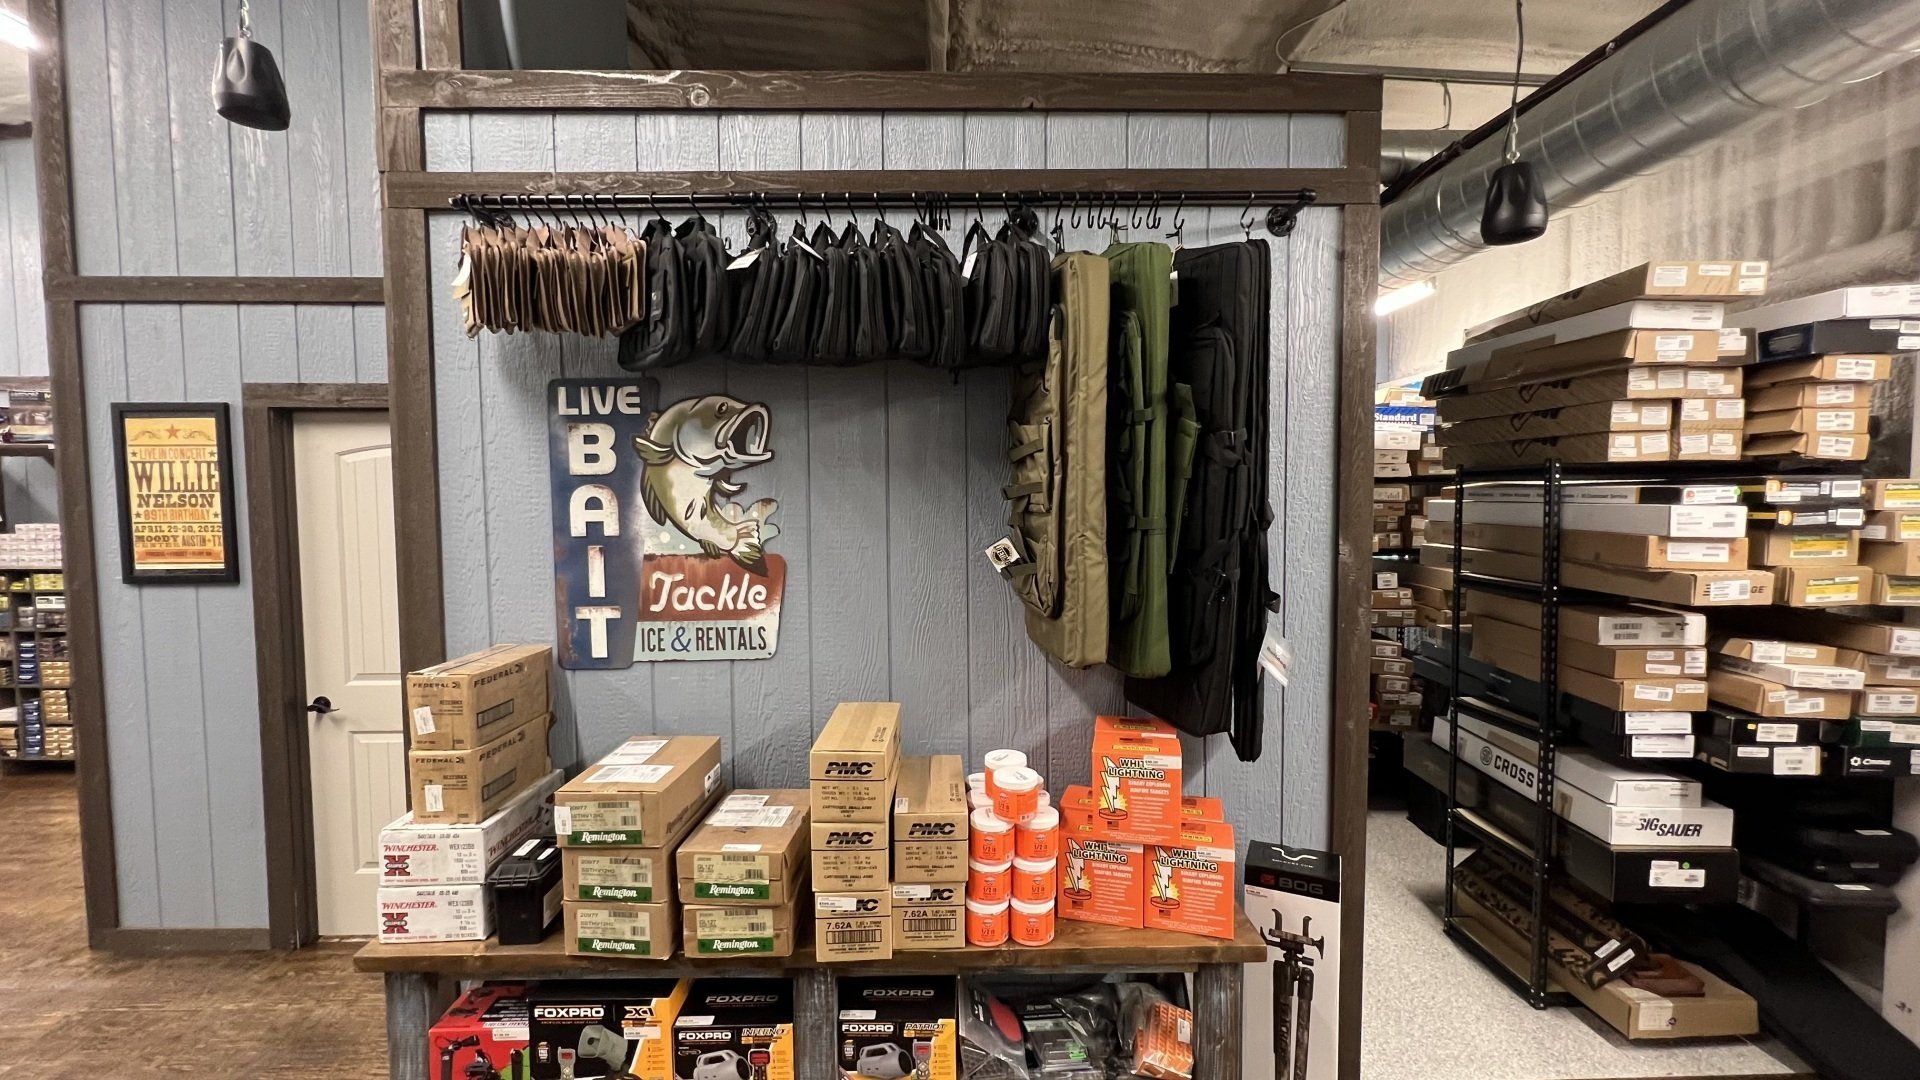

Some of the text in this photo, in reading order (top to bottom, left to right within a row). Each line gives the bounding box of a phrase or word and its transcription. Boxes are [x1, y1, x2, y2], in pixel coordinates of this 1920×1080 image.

[557, 386, 641, 415] LIVE
[1374, 412, 1418, 422] Standard
[140, 448, 206, 459] LIVE IN CONCERT
[130, 460, 220, 492] WILLIE
[137, 493, 214, 508] NELSON
[144, 509, 210, 520] 89TH BIRTHDAY
[135, 525, 164, 533] APRIL
[198, 525, 222, 533] 2022
[182, 535, 223, 547] AUSTIN TX
[567, 423, 621, 658] BAIT
[649, 571, 767, 612] Tackle
[641, 626, 767, 652] ICE & RENTALS
[474, 668, 514, 689] FEDERAL
[479, 735, 517, 762] FEDERAL
[825, 762, 873, 775] PMC
[1120, 758, 1145, 768] WHIT
[1108, 767, 1165, 779] LIGHTNING
[1494, 755, 1534, 788] CROSS
[909, 822, 956, 835] PMC
[1636, 818, 1703, 837] SIG SAUER
[581, 831, 627, 844] Remington
[826, 831, 873, 845] PMC
[383, 844, 438, 852] WINCHESTER
[1084, 842, 1108, 851] WHIT
[1073, 849, 1127, 862] LIGHTNING
[1172, 848, 1197, 859] WHIT
[1160, 857, 1217, 871] LIGHTNING
[709, 884, 754, 897] Remington
[1279, 877, 1323, 895] BOG
[593, 886, 637, 899] Remington
[381, 901, 437, 909] WINCHESTER
[826, 922, 852, 930] 7.62A
[592, 939, 636, 951] Remington
[713, 939, 759, 951] Remington
[705, 995, 779, 1003] FOXPRO
[863, 989, 935, 997] FOXPRO
[534, 1007, 604, 1018] FOXPRO
[741, 1027, 790, 1037] INFERNO
[842, 1024, 894, 1032] FOXPRO
[904, 1022, 946, 1031] PATRIOT
[678, 1031, 732, 1041] FOXPRO
